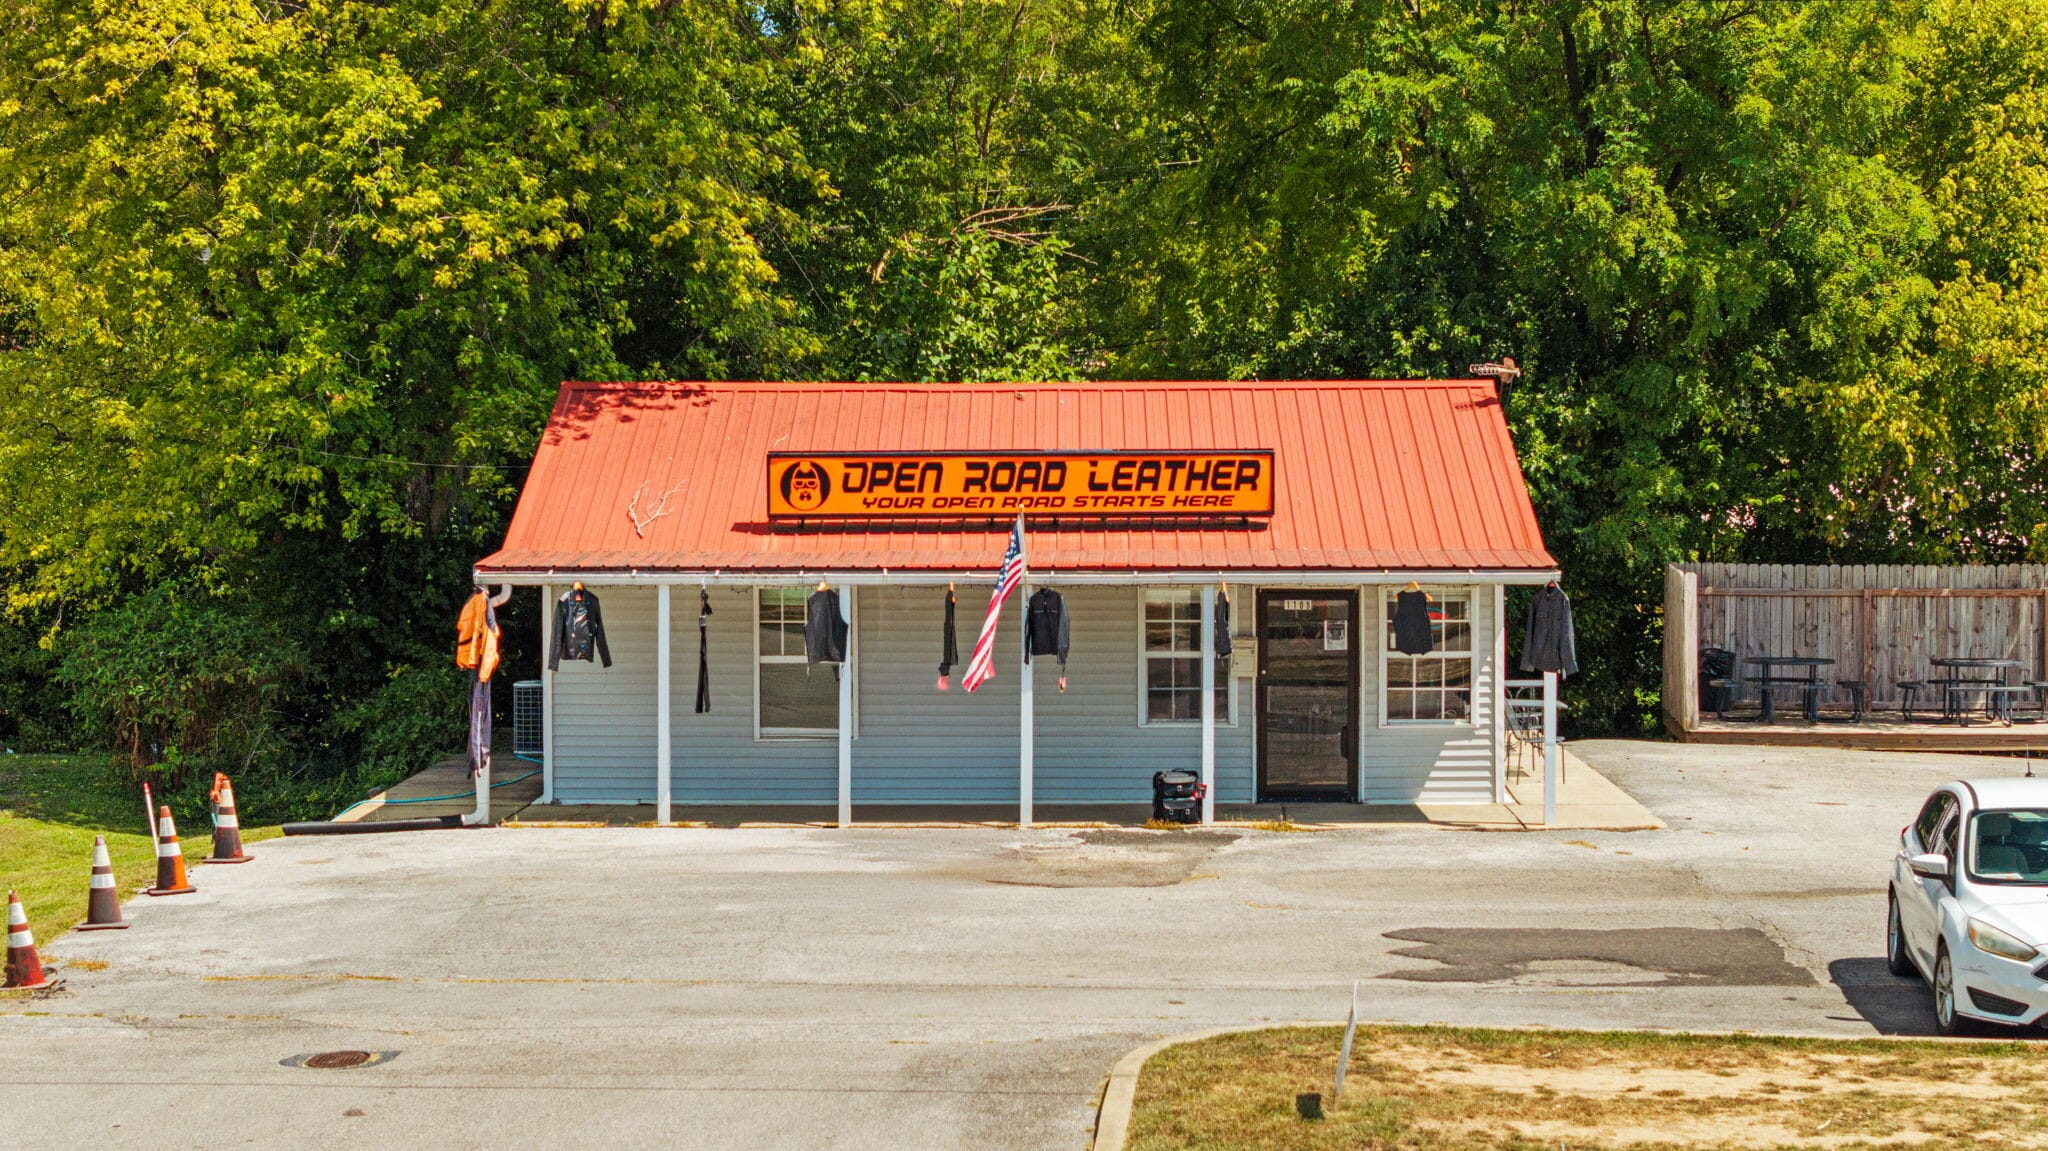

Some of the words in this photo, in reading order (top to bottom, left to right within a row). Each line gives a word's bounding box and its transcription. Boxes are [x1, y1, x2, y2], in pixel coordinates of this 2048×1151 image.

[842, 461, 944, 493] OPEN
[963, 461, 1067, 493] ROAD
[1088, 459, 1261, 492] LEATHER
[862, 496, 925, 509] YOUR
[931, 496, 994, 509] OPEN
[1001, 495, 1066, 508] ROAD
[1073, 495, 1166, 508] STARTS
[1172, 495, 1235, 507] HERE
